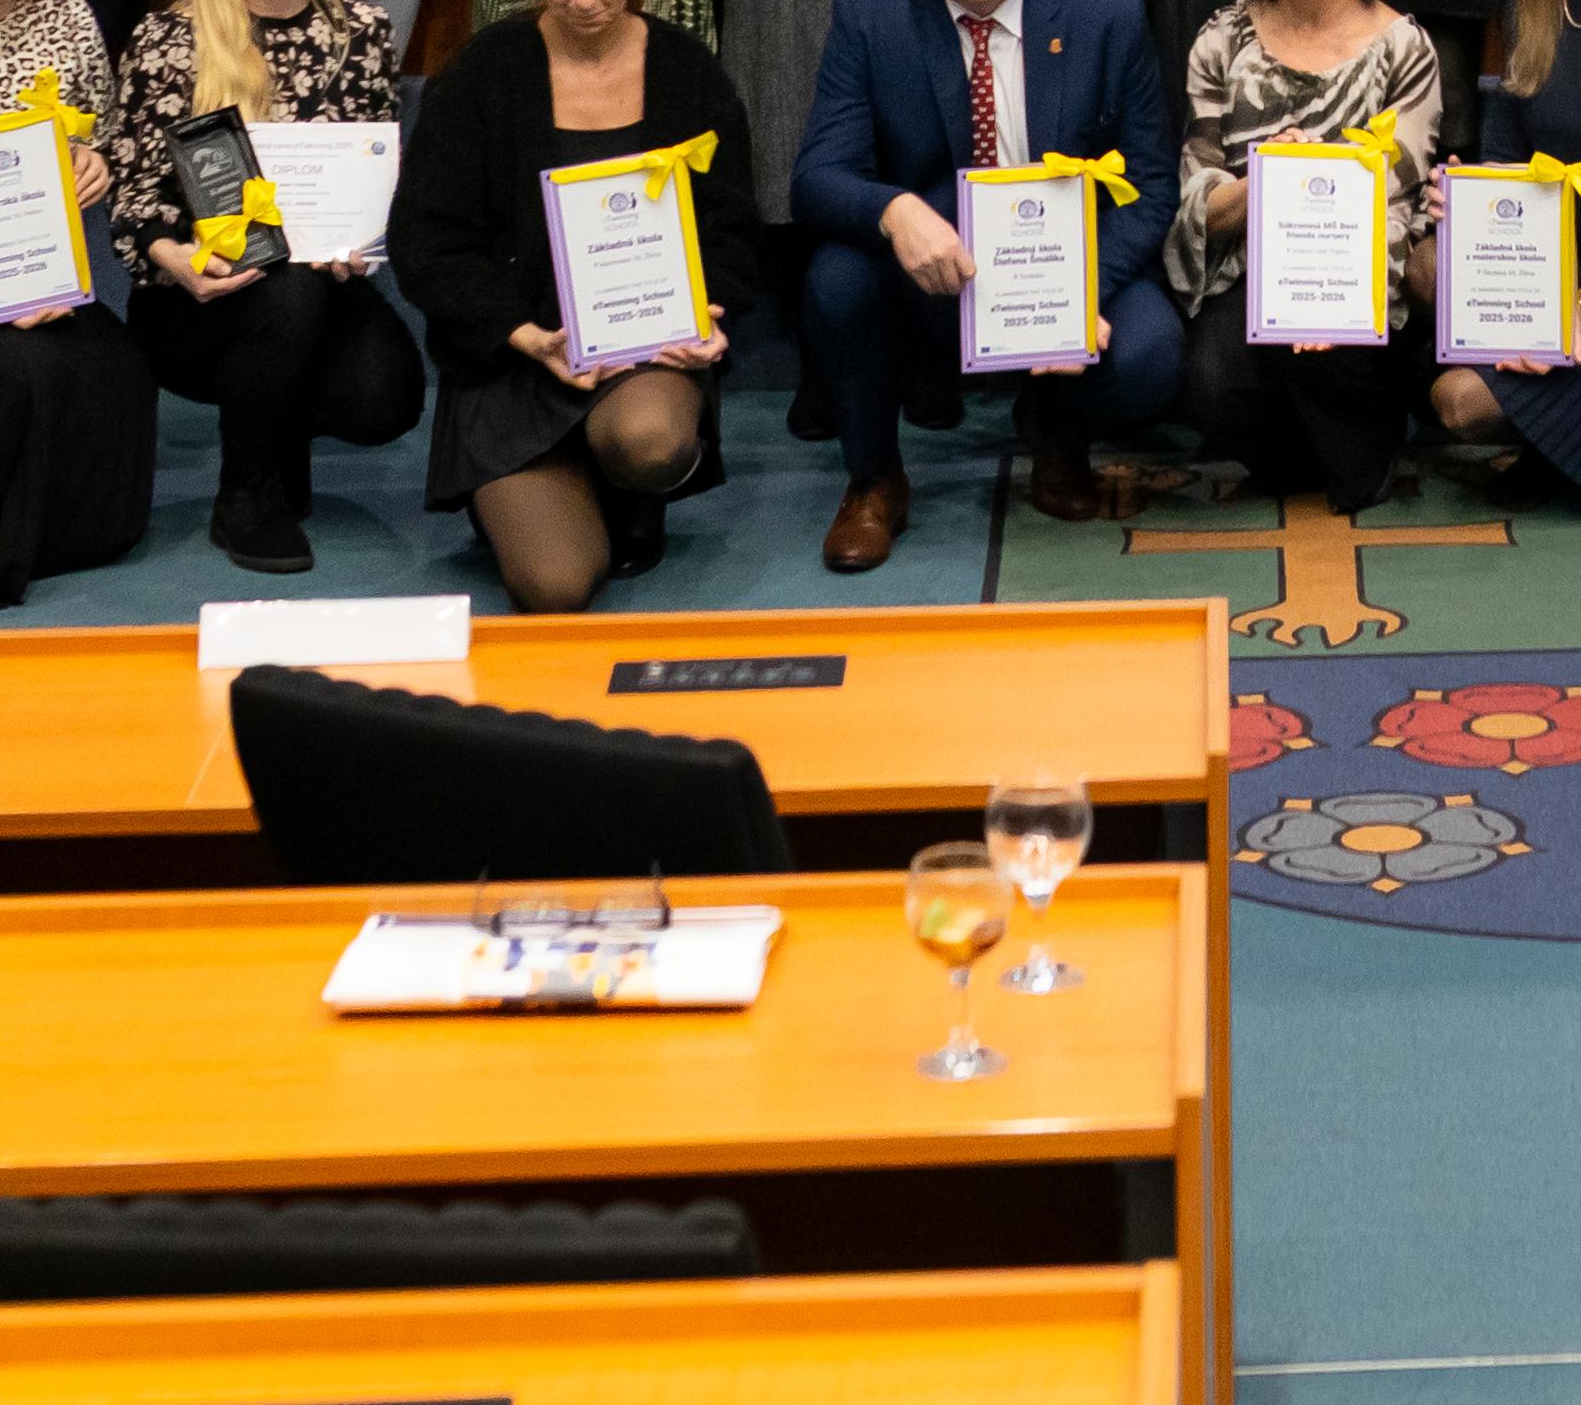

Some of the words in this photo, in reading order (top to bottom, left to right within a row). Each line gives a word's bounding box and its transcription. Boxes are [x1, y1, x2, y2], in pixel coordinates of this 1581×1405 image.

[1327, 277, 1359, 288] School
[1290, 291, 1347, 302] 2025-2026
[1514, 298, 1546, 309] School
[1479, 313, 1533, 324] 2025-2026
